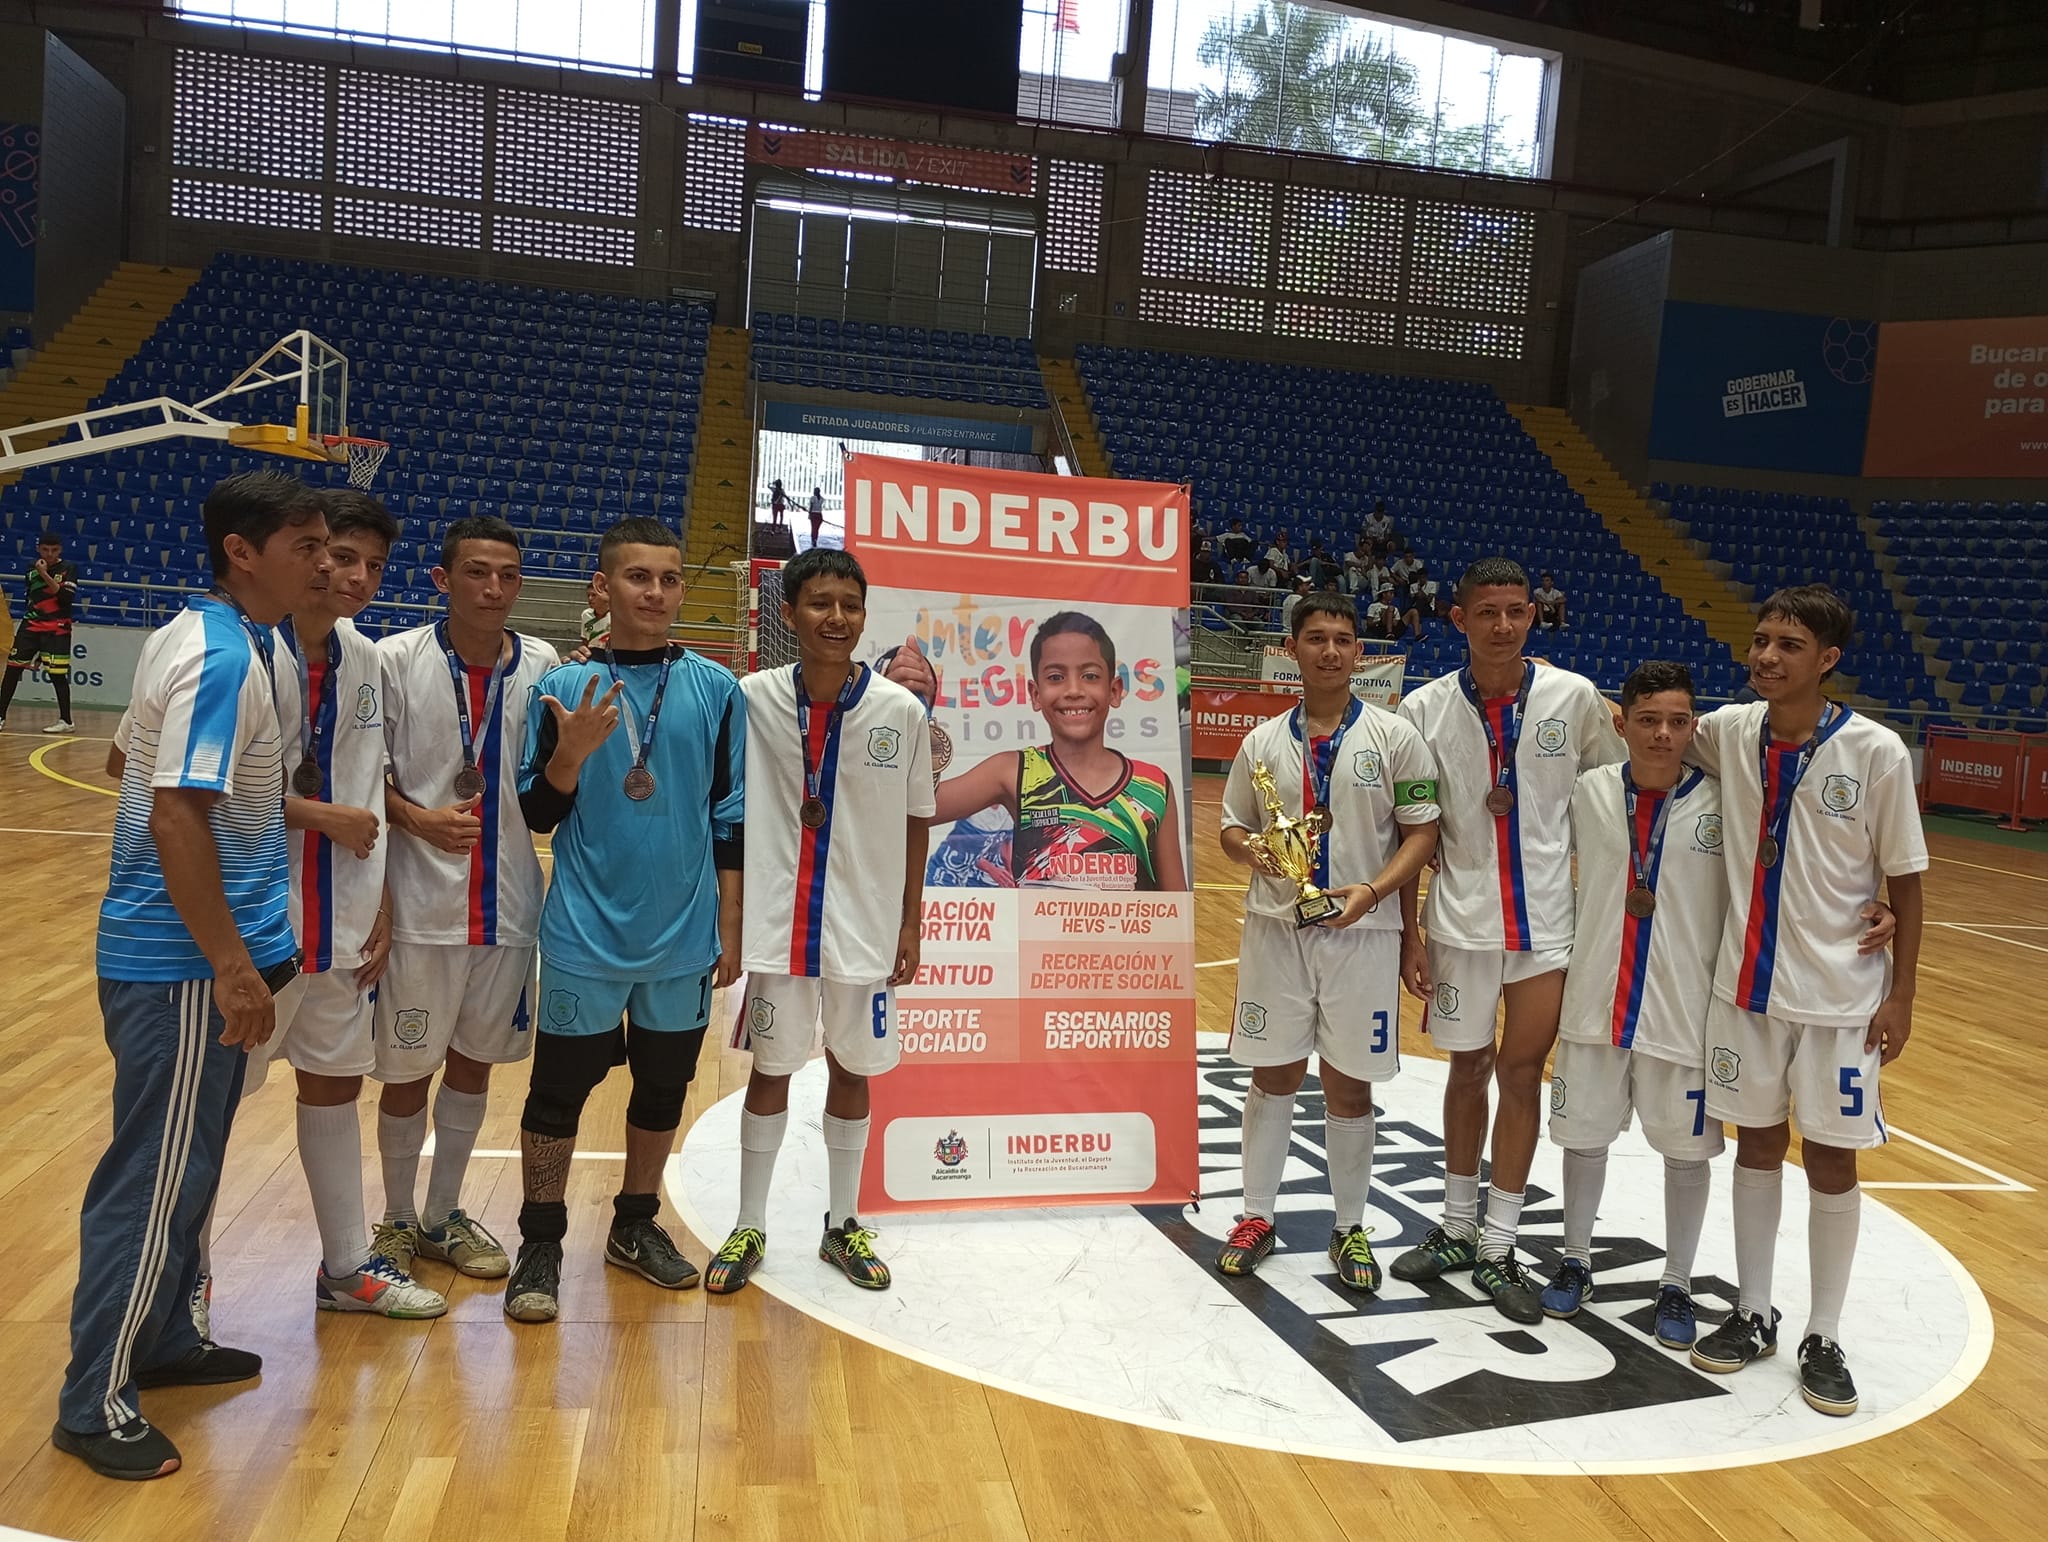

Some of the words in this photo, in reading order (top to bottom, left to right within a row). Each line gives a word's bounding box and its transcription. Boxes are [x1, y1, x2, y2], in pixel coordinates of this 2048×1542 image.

[826, 143, 910, 169] SALIDA
[928, 158, 969, 176] EXIT
[1727, 369, 1795, 394] GOBERNAR
[1994, 368, 2026, 388] de
[1726, 398, 1740, 412] ES
[1747, 386, 1803, 411] HACER
[1984, 398, 2045, 419] para
[802, 414, 849, 427] ENTRADA
[851, 419, 910, 433] JUGADORES
[953, 431, 997, 441] ENTRANCE
[856, 479, 1178, 561] INDERBU
[1196, 711, 1275, 727] INDERB
[1940, 759, 2003, 778] INDERBU
[1407, 783, 1428, 801] C
[1034, 901, 1122, 917] ACTIVIDAD
[1126, 899, 1178, 918] FÍSICA
[1062, 919, 1105, 933] HEVS
[1121, 919, 1151, 934] VAS
[1041, 951, 1156, 971] RECREACIÓN
[1161, 955, 1173, 971] Y
[1030, 973, 1114, 989] DEPORTE
[1117, 973, 1184, 990] SOCIAL
[511, 985, 530, 1032] 4
[696, 975, 708, 1022] 1
[872, 992, 887, 1038] 8
[1044, 1011, 1172, 1030] ESCENARIOS
[1045, 1030, 1171, 1049] DEPORTIVOS
[1370, 1010, 1389, 1053] 3
[1839, 1067, 1864, 1117] 5
[1007, 1133, 1112, 1154] INDERBU
[1068, 1164, 1107, 1172] Bucaramanga
[1088, 1156, 1112, 1164] Deporte
